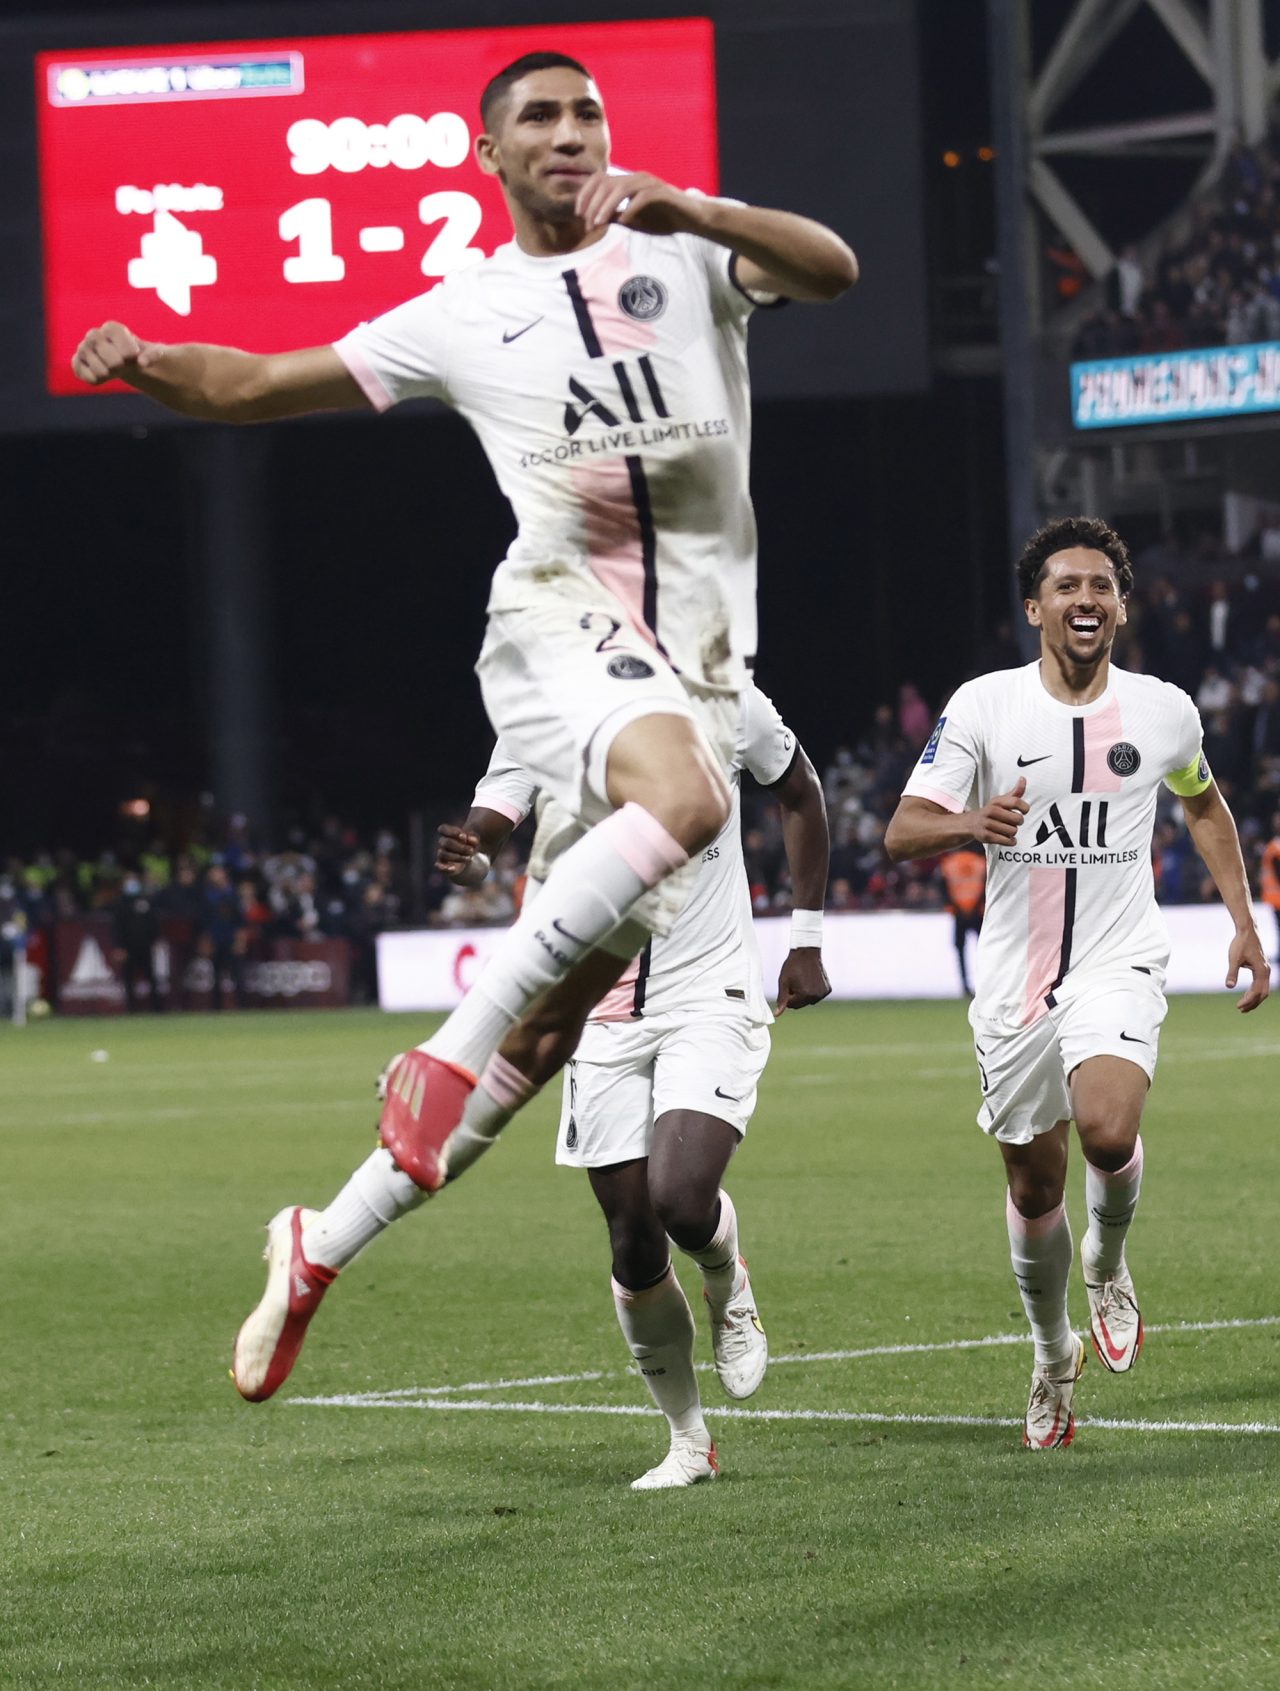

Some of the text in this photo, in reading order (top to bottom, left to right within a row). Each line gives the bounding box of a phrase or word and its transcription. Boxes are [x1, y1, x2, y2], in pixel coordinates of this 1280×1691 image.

[279, 197, 345, 283] 1
[418, 190, 486, 277] 2
[589, 431, 636, 453] LIVE
[641, 419, 729, 445] LIMITLESS
[998, 849, 1138, 865] ACCOR LIVE LIMITLESS
[533, 929, 575, 964] PAR
